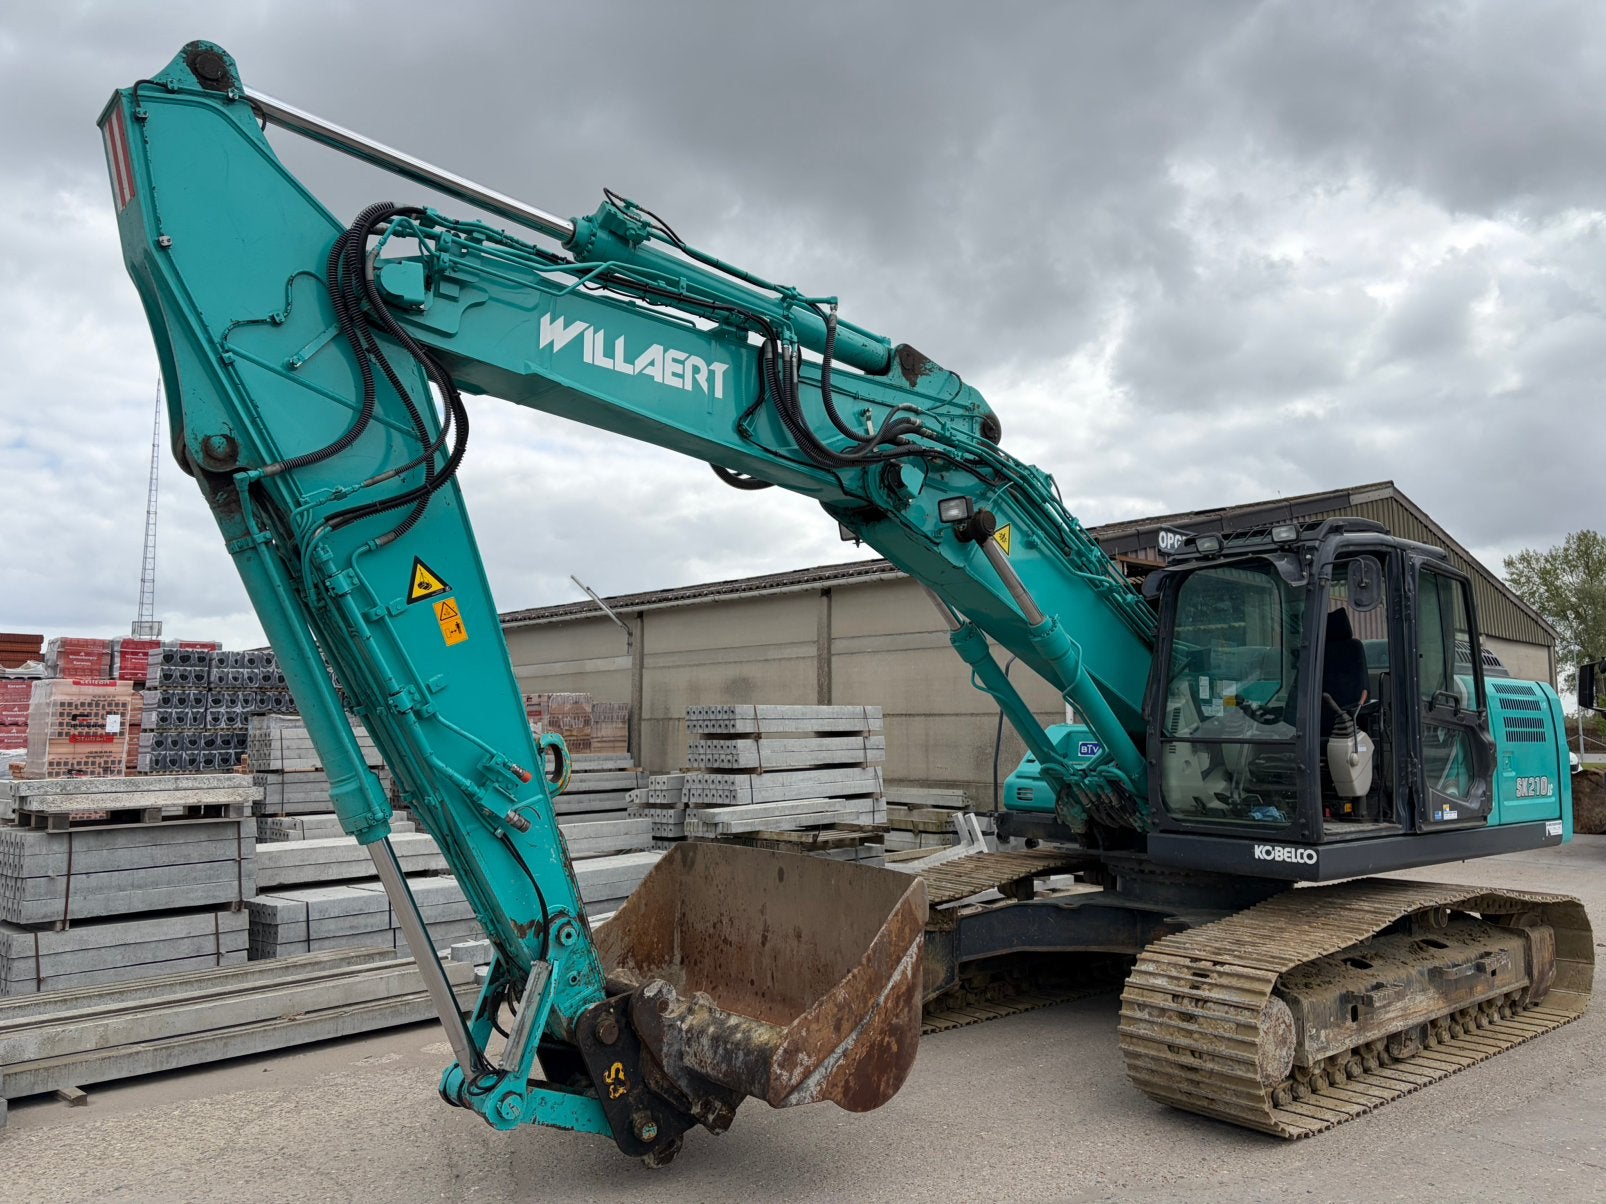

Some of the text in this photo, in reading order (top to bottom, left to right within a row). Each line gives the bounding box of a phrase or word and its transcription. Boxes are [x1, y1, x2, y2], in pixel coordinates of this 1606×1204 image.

[539, 312, 730, 399] WILLAERT
[1158, 531, 1187, 549] OPG
[1254, 844, 1318, 865] KOBELCO
